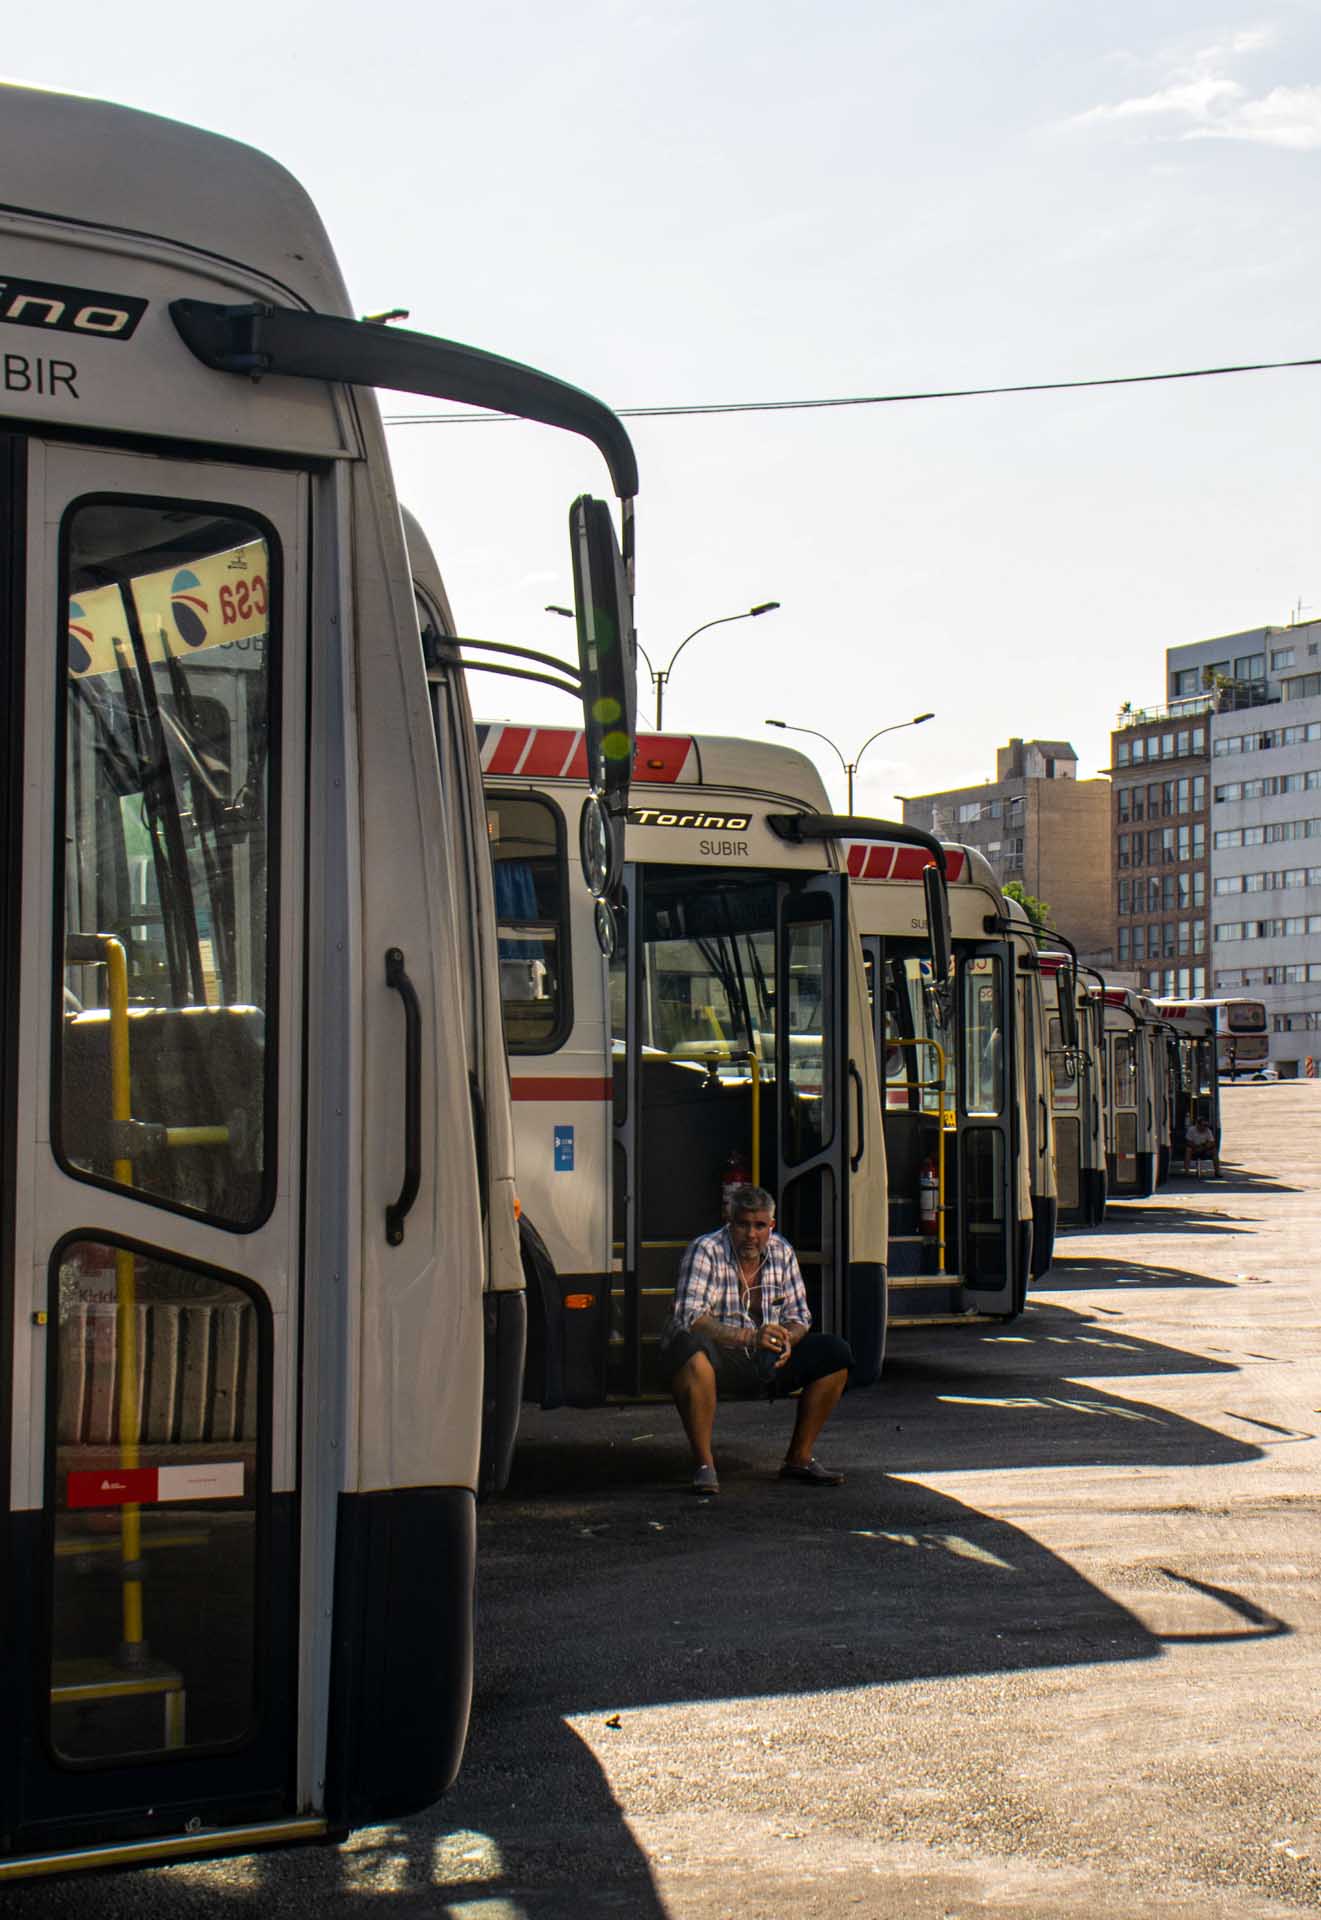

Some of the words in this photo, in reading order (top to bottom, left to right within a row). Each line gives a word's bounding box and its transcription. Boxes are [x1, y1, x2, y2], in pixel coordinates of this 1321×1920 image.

[4, 353, 80, 399] BIR
[634, 810, 748, 830] Torino
[699, 840, 749, 856] SUBIR
